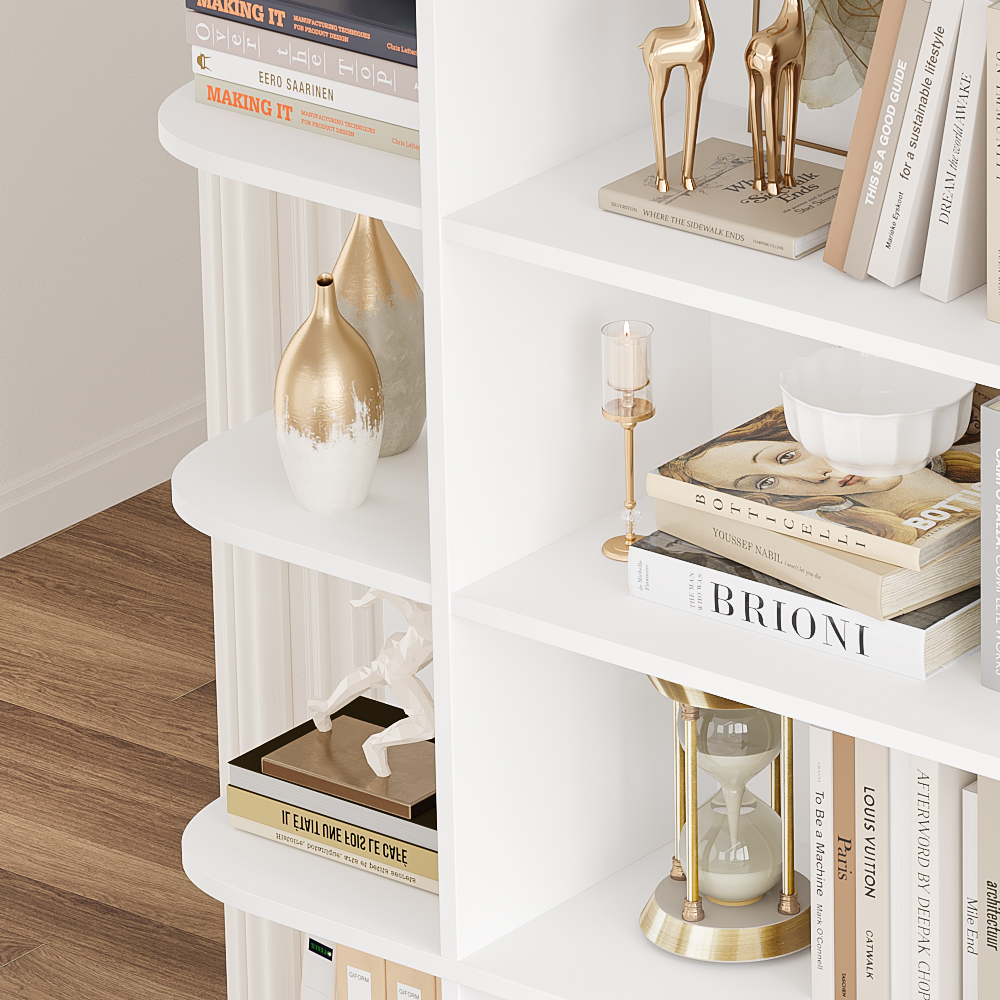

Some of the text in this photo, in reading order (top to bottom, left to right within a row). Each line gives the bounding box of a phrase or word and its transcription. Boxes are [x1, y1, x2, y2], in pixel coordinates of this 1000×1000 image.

[268, 7, 285, 28] IT
[195, 22, 394, 87] Over the Top
[207, 84, 293, 122] MAKING IT
[259, 70, 334, 102] EERO SAARINEN
[900, 25, 946, 181] for a sustainable lifestyle
[301, 118, 355, 138] FOR PRODUCT DESIGN
[865, 59, 907, 206] THIS IS A GOOD GUIDE
[938, 72, 972, 225] DREAM the world AWAKE
[642, 208, 745, 242] WHERE THE SIDEWALK ENDS
[695, 493, 867, 549] BOTTICELLI
[712, 527, 783, 564] YOUSSEF NABIL
[710, 581, 869, 657] BRIONI
[815, 791, 825, 805] To
[815, 809, 825, 827] Be
[816, 830, 823, 838] a
[837, 835, 853, 881] Paris
[864, 786, 876, 899] LOUIS VUITTON
[815, 842, 825, 897] Machine
[917, 768, 931, 957] AFTERWORD BY DEEPAK
[816, 903, 824, 971] Mark O'Connell
[967, 897, 978, 955] Mile End
[986, 880, 1000, 951] architectuur
[348, 971, 370, 984] GIFORM
[865, 929, 874, 980] CATWALK
[398, 988, 420, 1000] GIFORM
